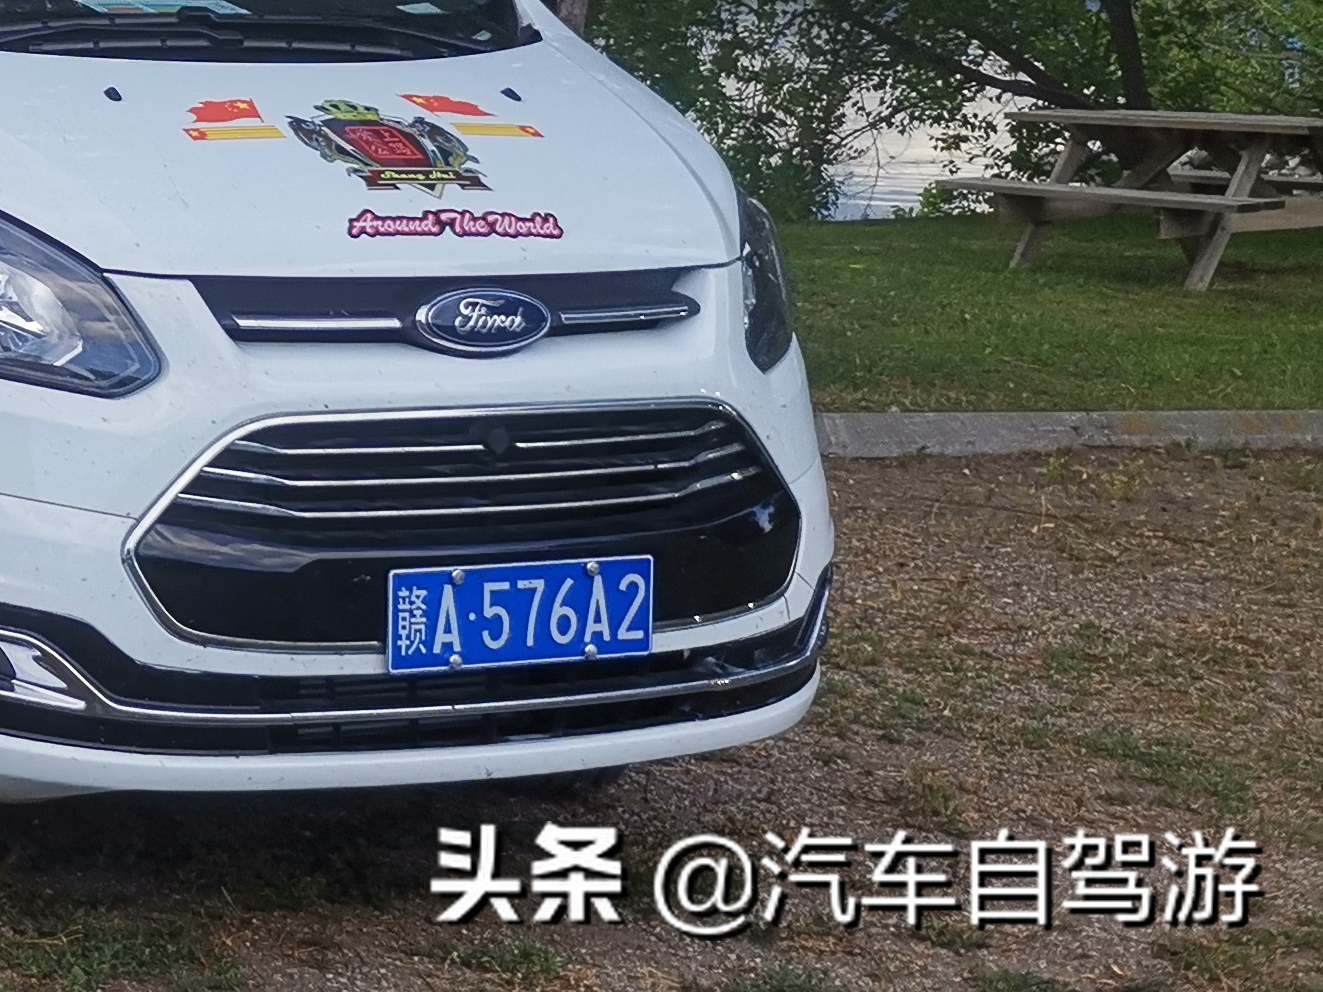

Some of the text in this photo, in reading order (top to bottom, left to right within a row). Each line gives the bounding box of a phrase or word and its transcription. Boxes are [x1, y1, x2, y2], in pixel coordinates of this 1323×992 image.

[352, 210, 562, 238] Around The World
[455, 297, 526, 335] Ford
